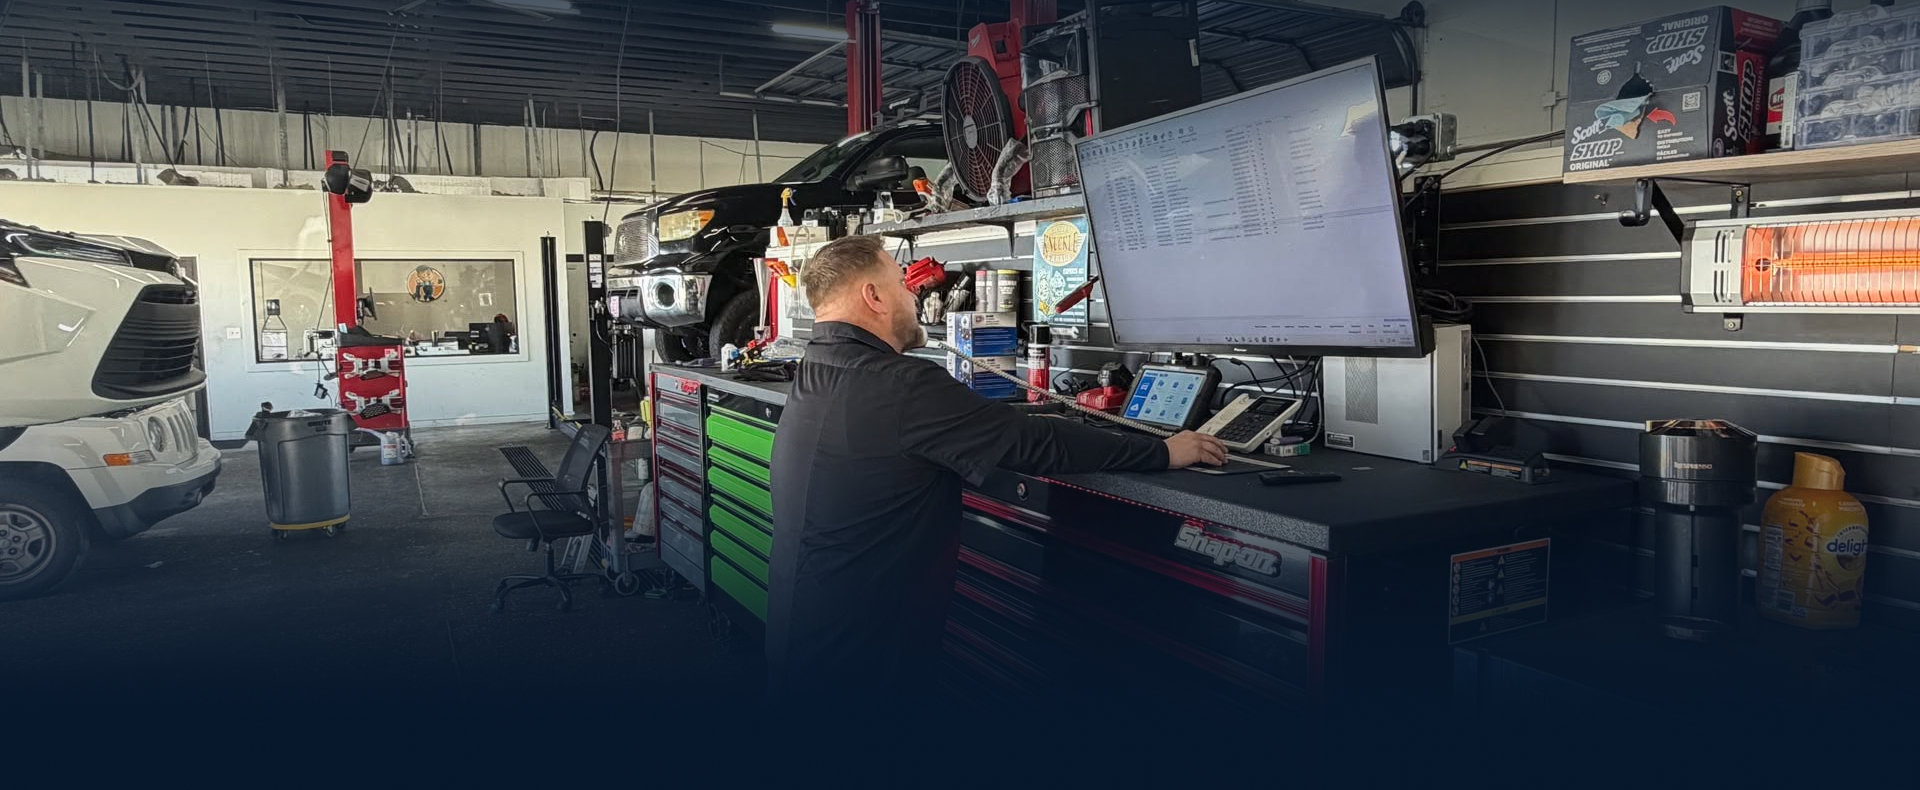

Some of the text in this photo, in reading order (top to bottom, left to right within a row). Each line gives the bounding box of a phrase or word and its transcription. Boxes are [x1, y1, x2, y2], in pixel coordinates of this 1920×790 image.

[1661, 15, 1708, 31] ORIGINAL
[1646, 26, 1708, 54] SHOP
[1663, 45, 1705, 74] Scott
[1738, 59, 1756, 143] SHOP
[1755, 66, 1764, 111] ORIGINAL
[1723, 90, 1738, 141] Scott
[1571, 120, 1604, 144] Scott
[1570, 138, 1623, 161] SHOP
[1570, 160, 1610, 171] ORIGINAL
[1043, 231, 1078, 255] KNUCKLE
